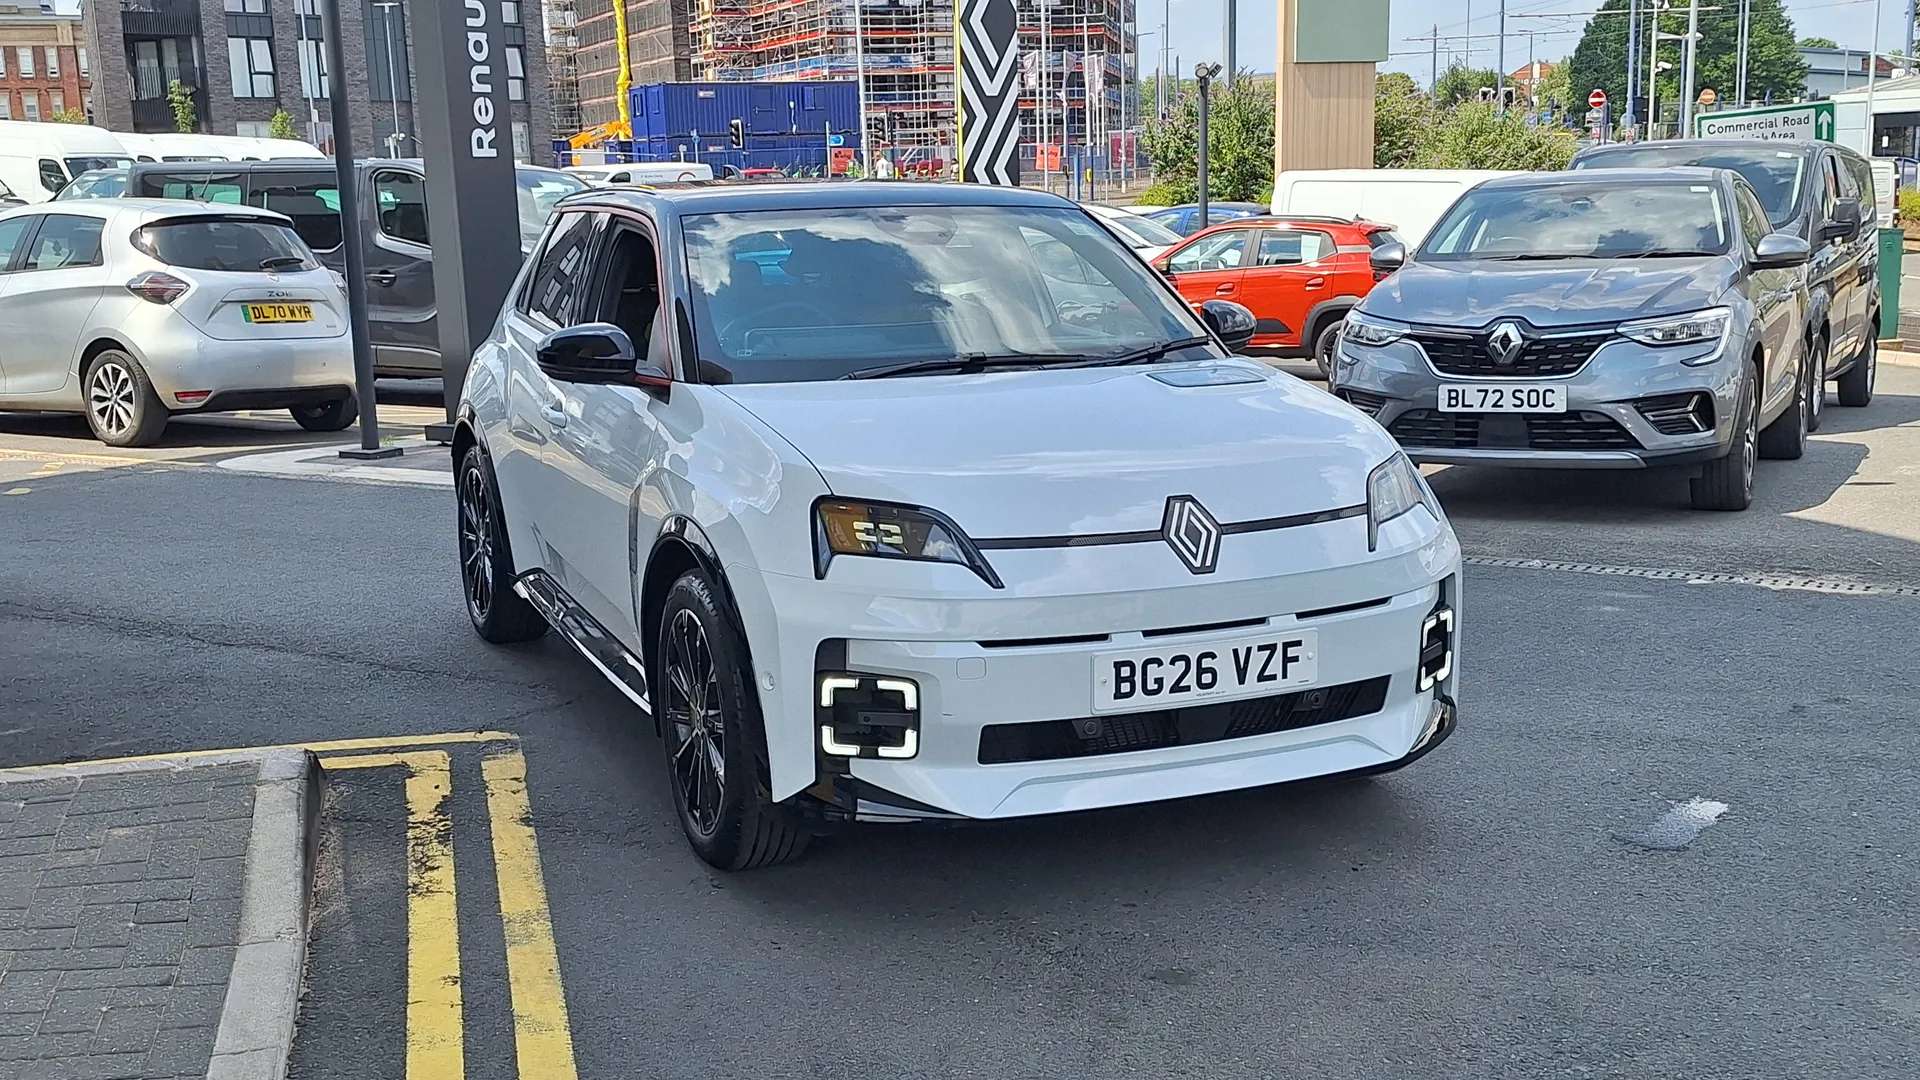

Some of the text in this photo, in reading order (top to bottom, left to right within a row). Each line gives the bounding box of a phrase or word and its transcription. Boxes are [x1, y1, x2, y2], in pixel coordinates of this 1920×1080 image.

[464, 0, 498, 158] Renau
[1707, 114, 1810, 135] Commercial Road
[251, 305, 312, 319] DL70 WYR
[1447, 389, 1556, 408] BL72 SOC
[1113, 639, 1303, 700] BG26 VZF
